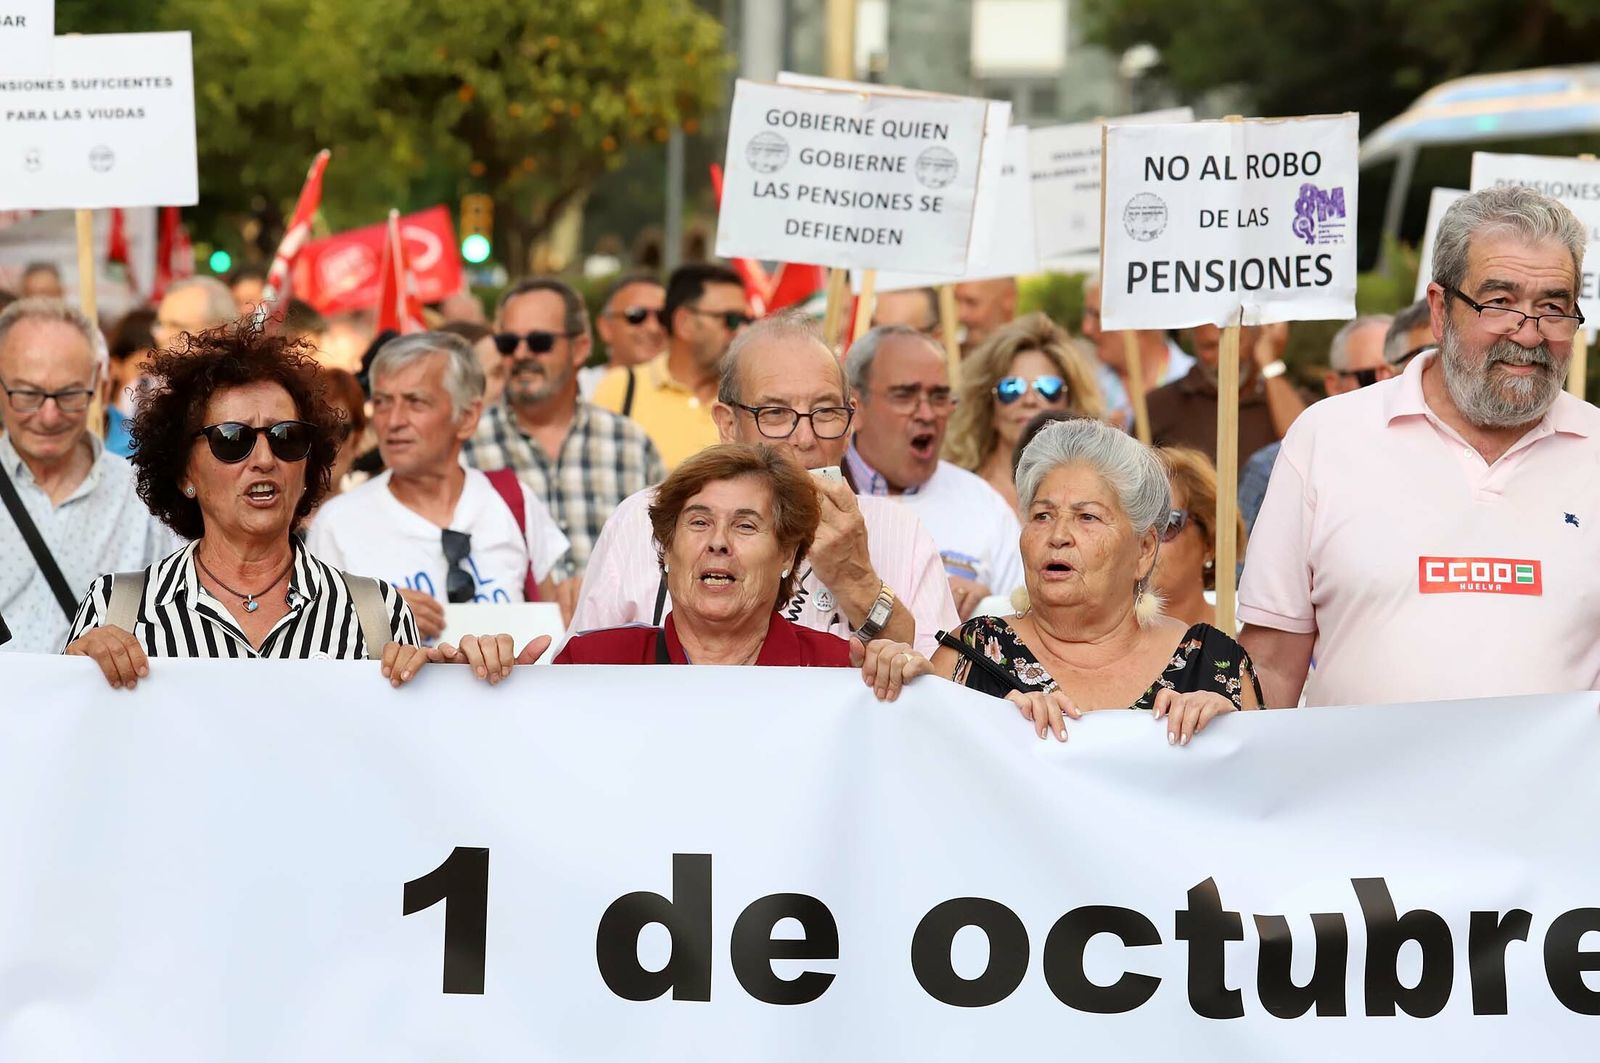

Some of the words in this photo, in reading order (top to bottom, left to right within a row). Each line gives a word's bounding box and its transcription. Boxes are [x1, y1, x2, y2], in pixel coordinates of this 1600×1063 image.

[0, 15, 26, 27] AR
[71, 76, 173, 90] SUFICIENTES
[6, 109, 48, 121] PARA
[53, 109, 82, 120] LAS
[88, 107, 145, 120] VIUDAS
[766, 108, 875, 137] GOBIERNE
[882, 119, 949, 141] QUIEN
[800, 147, 907, 173] GOBIERNE
[1145, 155, 1189, 182] NO
[1200, 155, 1237, 181] AL
[1246, 150, 1322, 180] ROBO
[753, 181, 790, 199] LAS
[797, 185, 912, 211] PENSIONES
[920, 196, 943, 213] SE
[1200, 209, 1229, 228] DE
[1237, 207, 1269, 228] LAS
[785, 218, 903, 245] DEFIENDEN
[1127, 253, 1333, 294] PENSIONES
[1460, 583, 1502, 591] HUELVA
[402, 846, 490, 995] 1
[596, 852, 840, 1006] de
[910, 876, 1600, 1020] octubre
